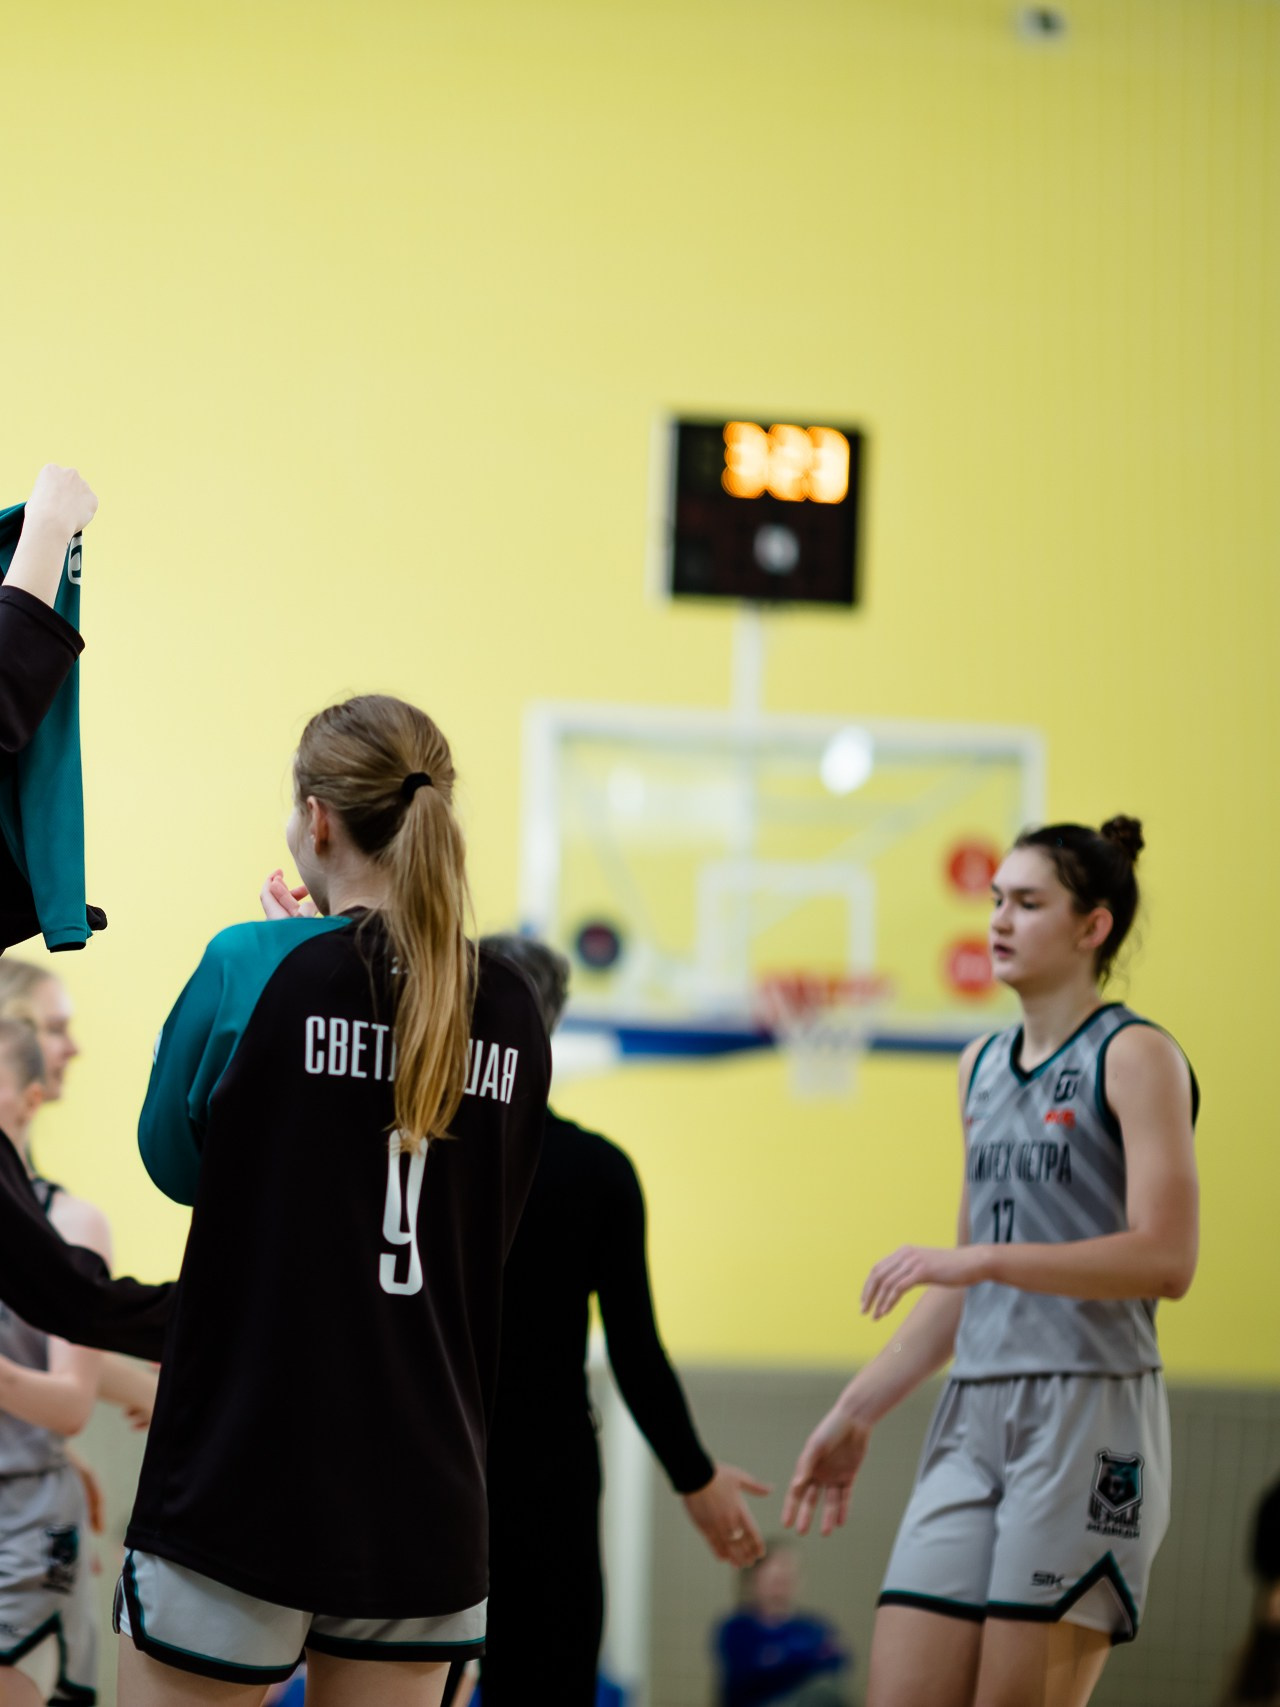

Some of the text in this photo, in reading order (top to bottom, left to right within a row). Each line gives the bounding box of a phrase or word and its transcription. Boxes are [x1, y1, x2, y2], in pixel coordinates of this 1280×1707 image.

[304, 1015, 519, 1104] СВЕТШАЯ
[1017, 1142, 1072, 1183] ПЕТРА
[379, 1128, 428, 1296] 9
[992, 1198, 1014, 1244] 17
